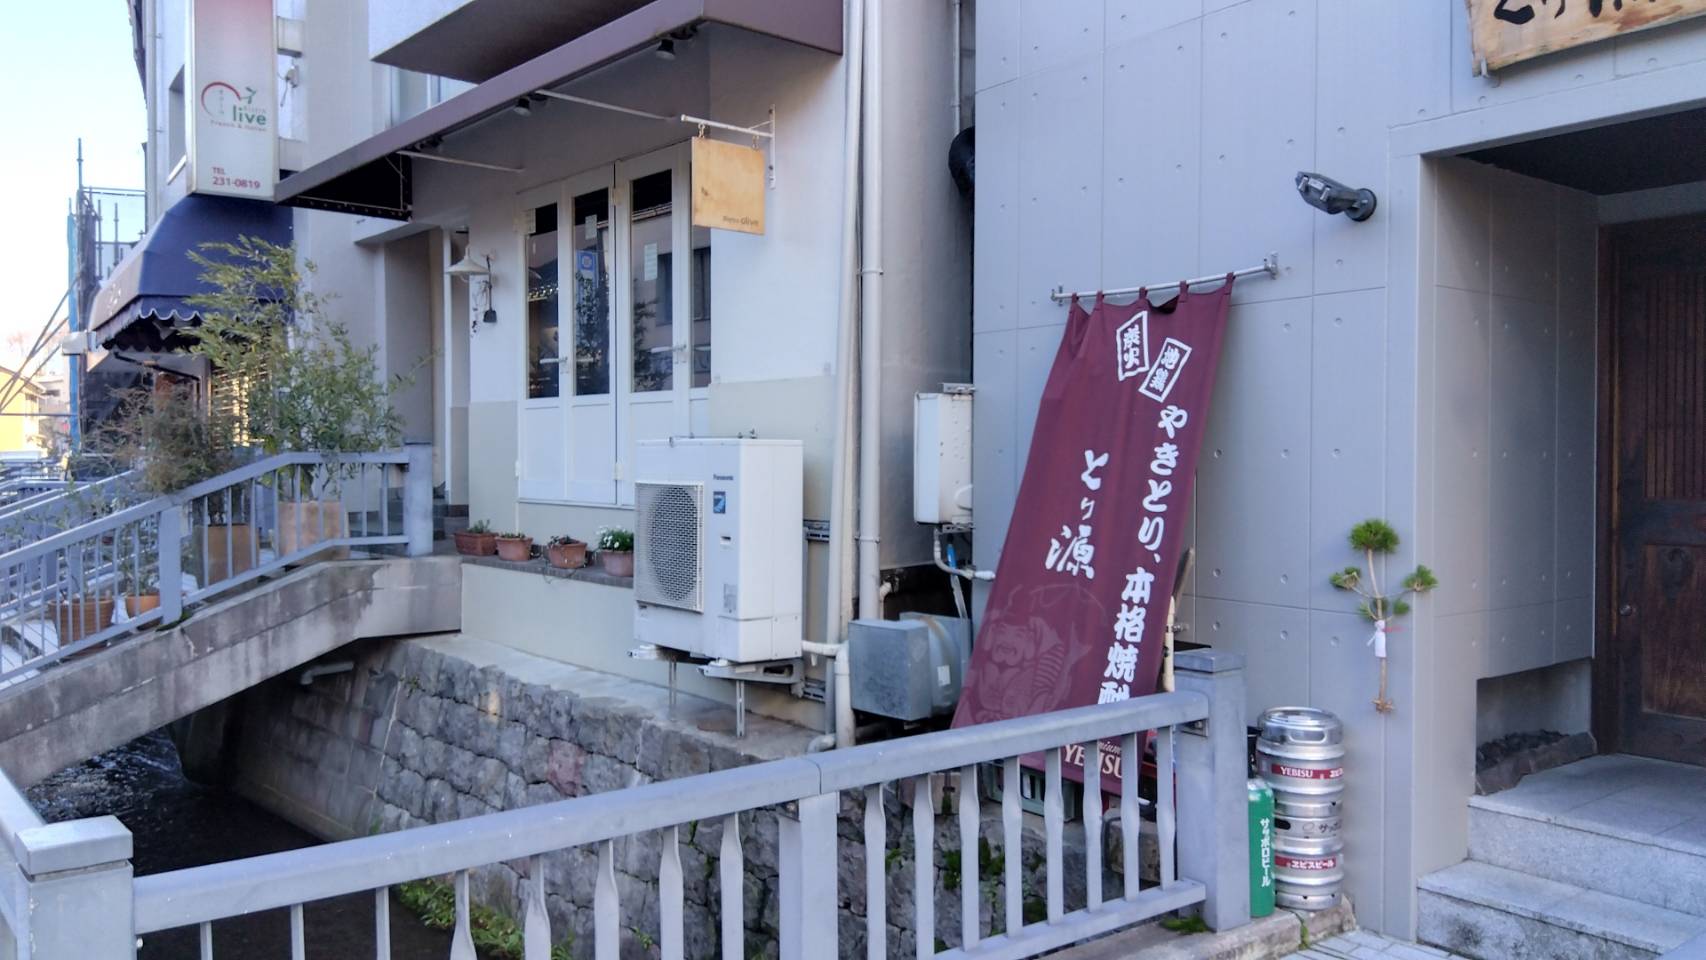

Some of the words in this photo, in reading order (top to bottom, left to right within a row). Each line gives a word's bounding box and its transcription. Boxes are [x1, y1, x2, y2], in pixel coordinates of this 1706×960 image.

[212, 176, 261, 189] 231-0819
[1045, 449, 1109, 579] とり源
[1280, 766, 1313, 778] YEBISU
[1260, 818, 1271, 887] サッポロビール
